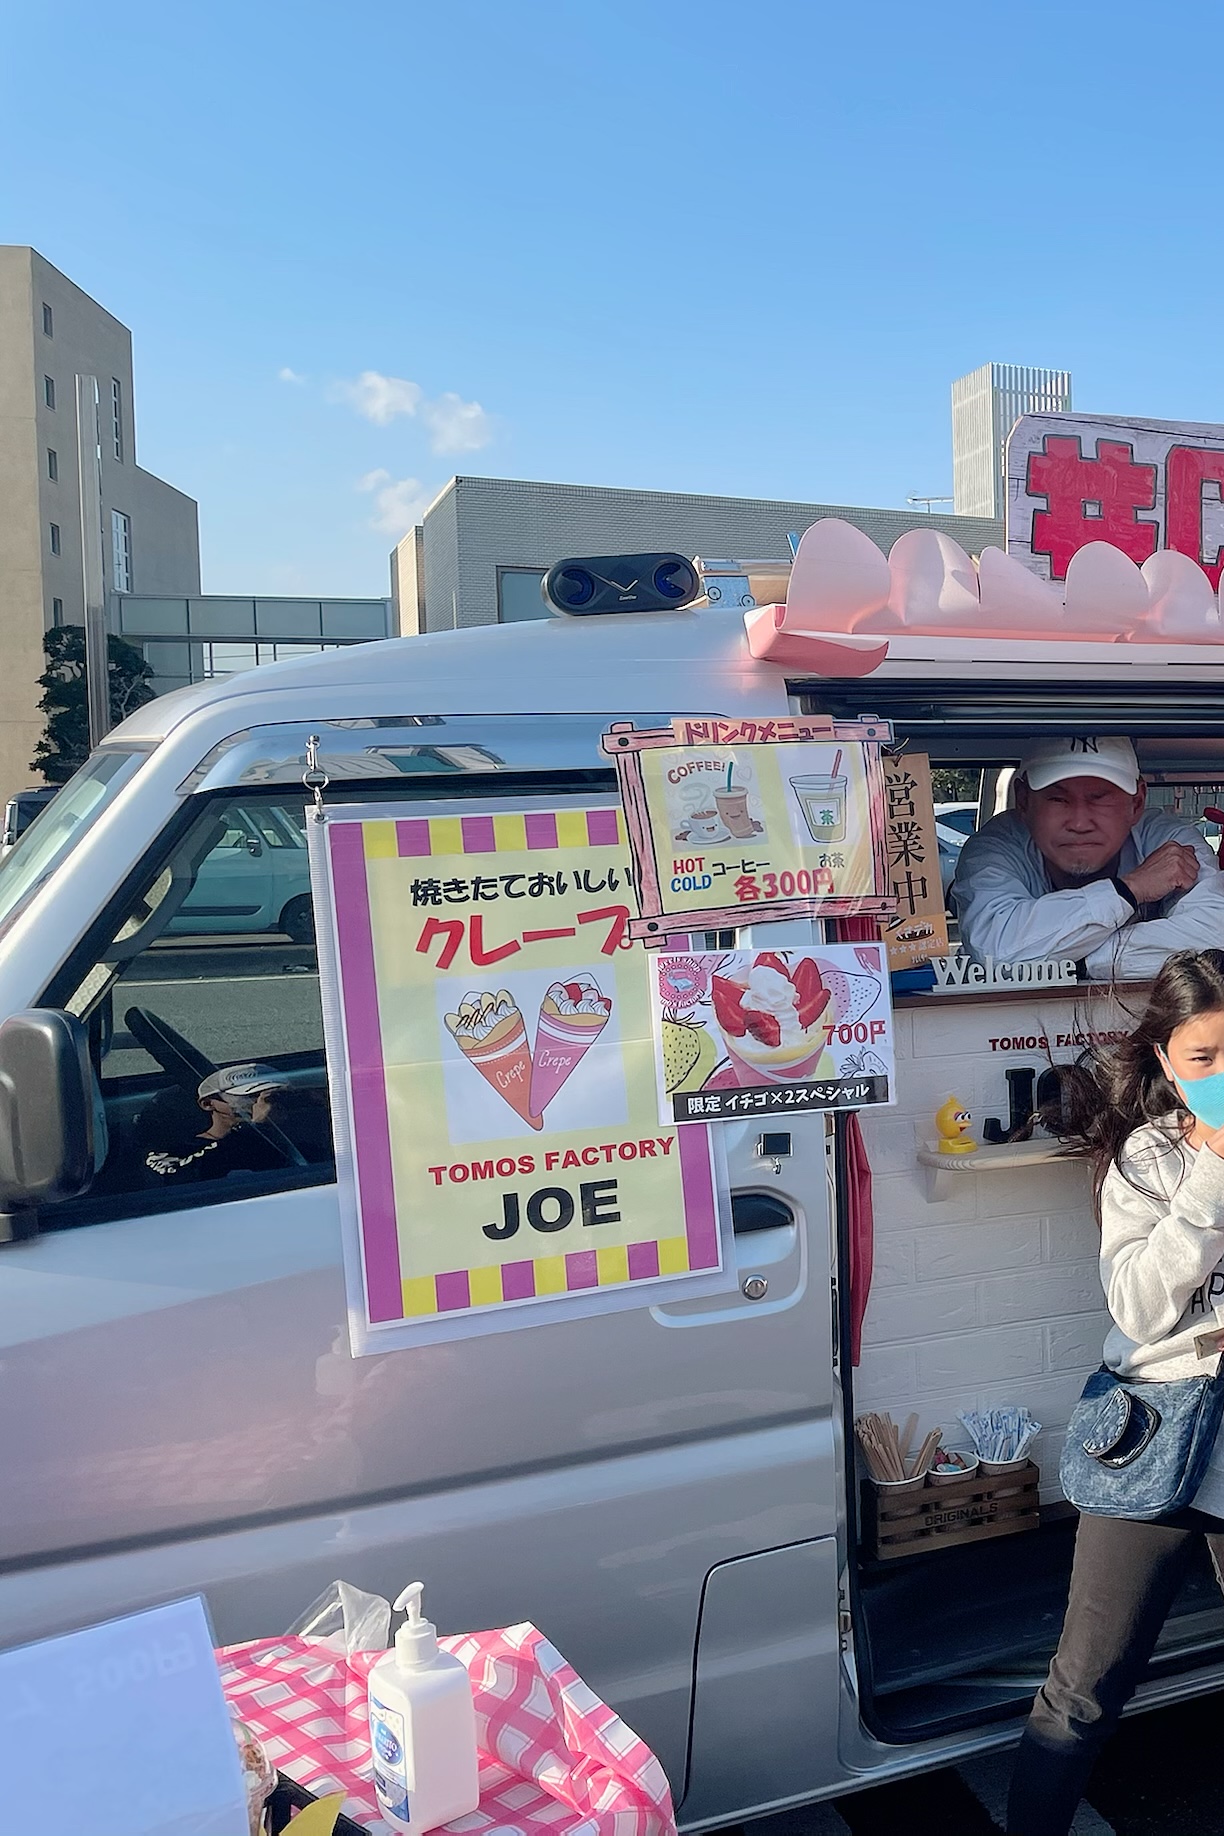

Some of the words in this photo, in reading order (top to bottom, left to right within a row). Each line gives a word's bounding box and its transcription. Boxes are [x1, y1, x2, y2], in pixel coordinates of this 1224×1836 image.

[685, 721, 831, 744] ドリンクメニュー
[667, 760, 725, 785] COFFEE!
[885, 772, 928, 916] 営業中
[673, 857, 706, 875] HOT
[712, 859, 771, 876] コーヒー
[819, 851, 845, 868] お茶
[410, 867, 634, 907] 焼きたておいしい
[671, 874, 712, 893] COLD
[733, 867, 835, 902] 各300円
[415, 904, 634, 969] クレープ
[929, 954, 1078, 986] Welcome
[822, 1019, 886, 1046] 700円
[989, 1036, 1048, 1051] TOMOS
[538, 1049, 572, 1074] Crepe
[496, 1060, 526, 1089] Crepe
[687, 1096, 722, 1114] 限定
[428, 1155, 535, 1186] TOMOS
[545, 1137, 675, 1172] FACTORY
[482, 1178, 622, 1241] JOE
[925, 1502, 998, 1527] ORIGINALS
